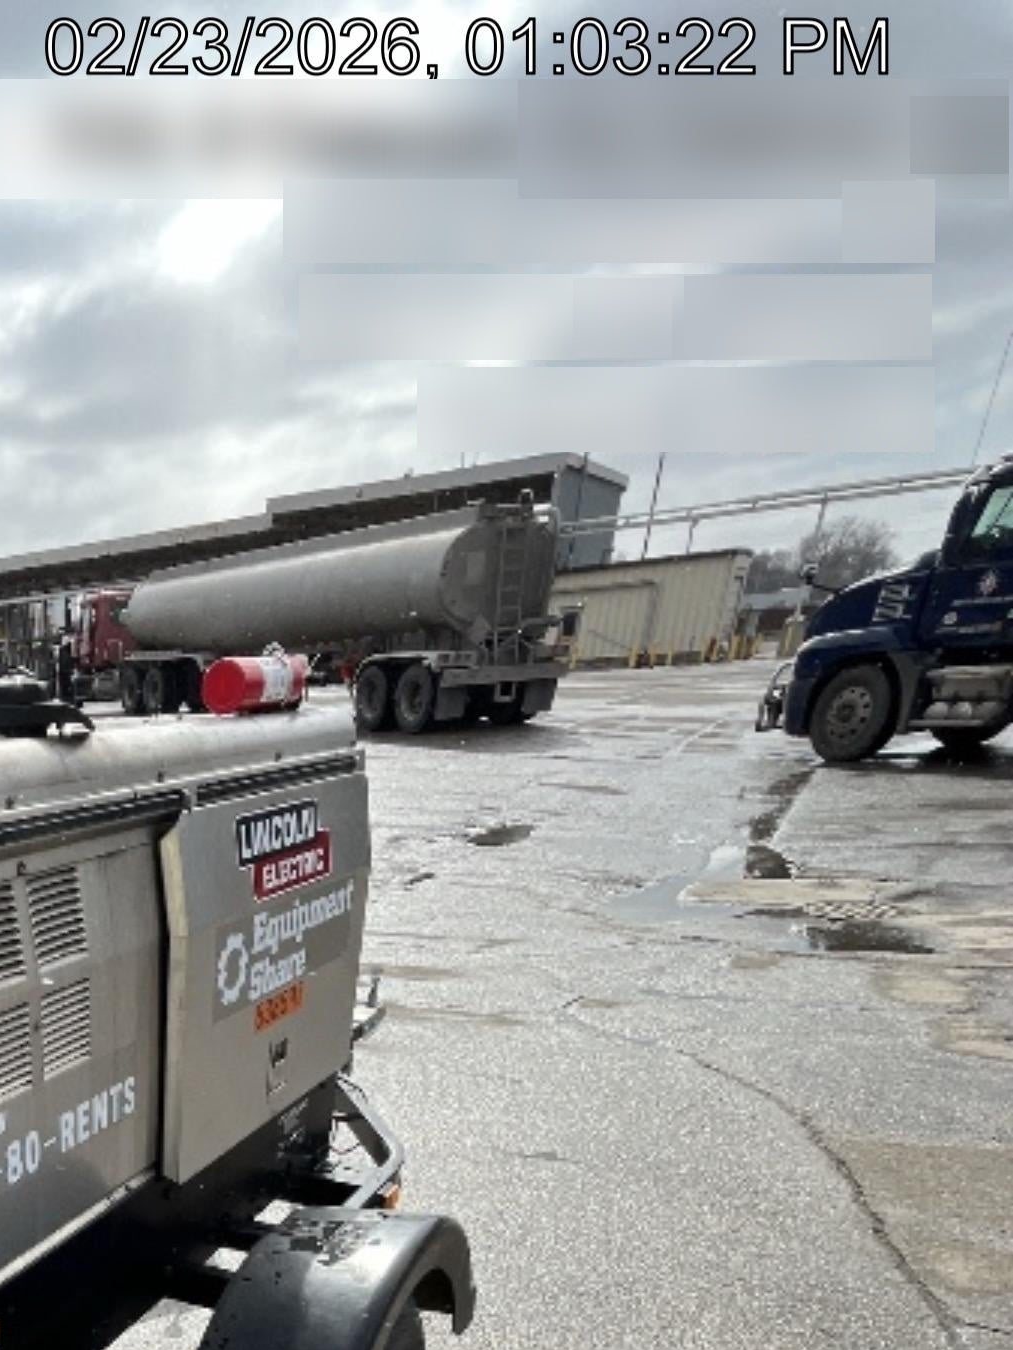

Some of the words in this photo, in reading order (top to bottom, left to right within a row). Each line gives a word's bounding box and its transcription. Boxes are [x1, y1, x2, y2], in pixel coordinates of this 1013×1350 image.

[241, 806, 316, 859] LINCOLN
[261, 848, 325, 890] ELECTRIC
[252, 878, 355, 955] Equipment
[248, 948, 307, 1002] Share
